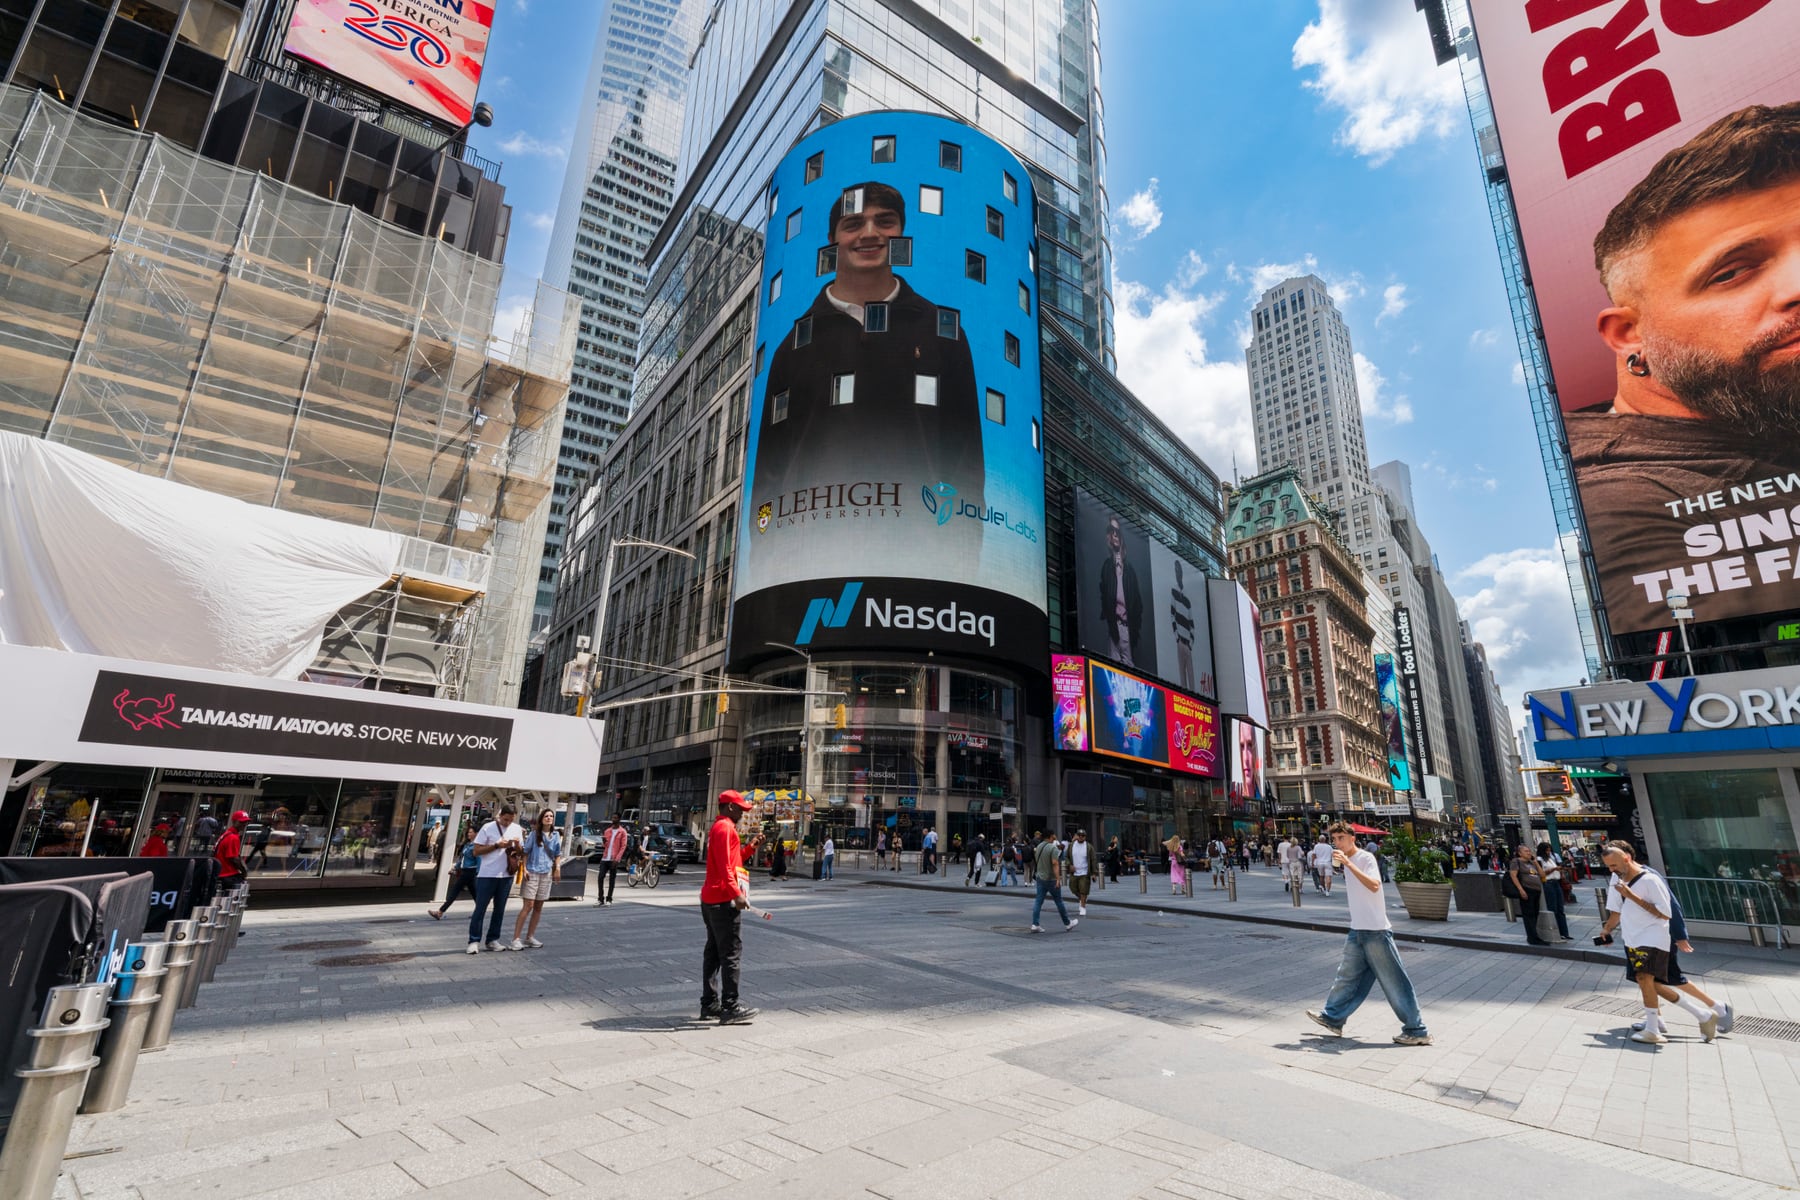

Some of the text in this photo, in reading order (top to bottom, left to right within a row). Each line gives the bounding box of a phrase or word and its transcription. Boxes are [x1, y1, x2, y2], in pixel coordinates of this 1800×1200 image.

[343, 0, 452, 68] 250
[423, 3, 460, 25] PARTNER
[777, 482, 903, 518] LEHIGH
[1664, 473, 1800, 518] THE NEW
[776, 508, 904, 528] UNIVERSITY
[955, 498, 1038, 543] JouleLabs
[1683, 504, 1800, 557] SIN
[1632, 546, 1800, 603] THE F
[864, 597, 995, 647] Nasdaq
[1397, 611, 1412, 648] Locker
[1403, 650, 1417, 675] Foot
[181, 707, 499, 751] TAMASHII NATIONS STORE NEW YORK
[1528, 677, 1800, 741] NEW YORK
[1181, 723, 1216, 757] Juliet
[868, 770, 896, 779] Nasdaq
[1561, 776, 1570, 791] 3
